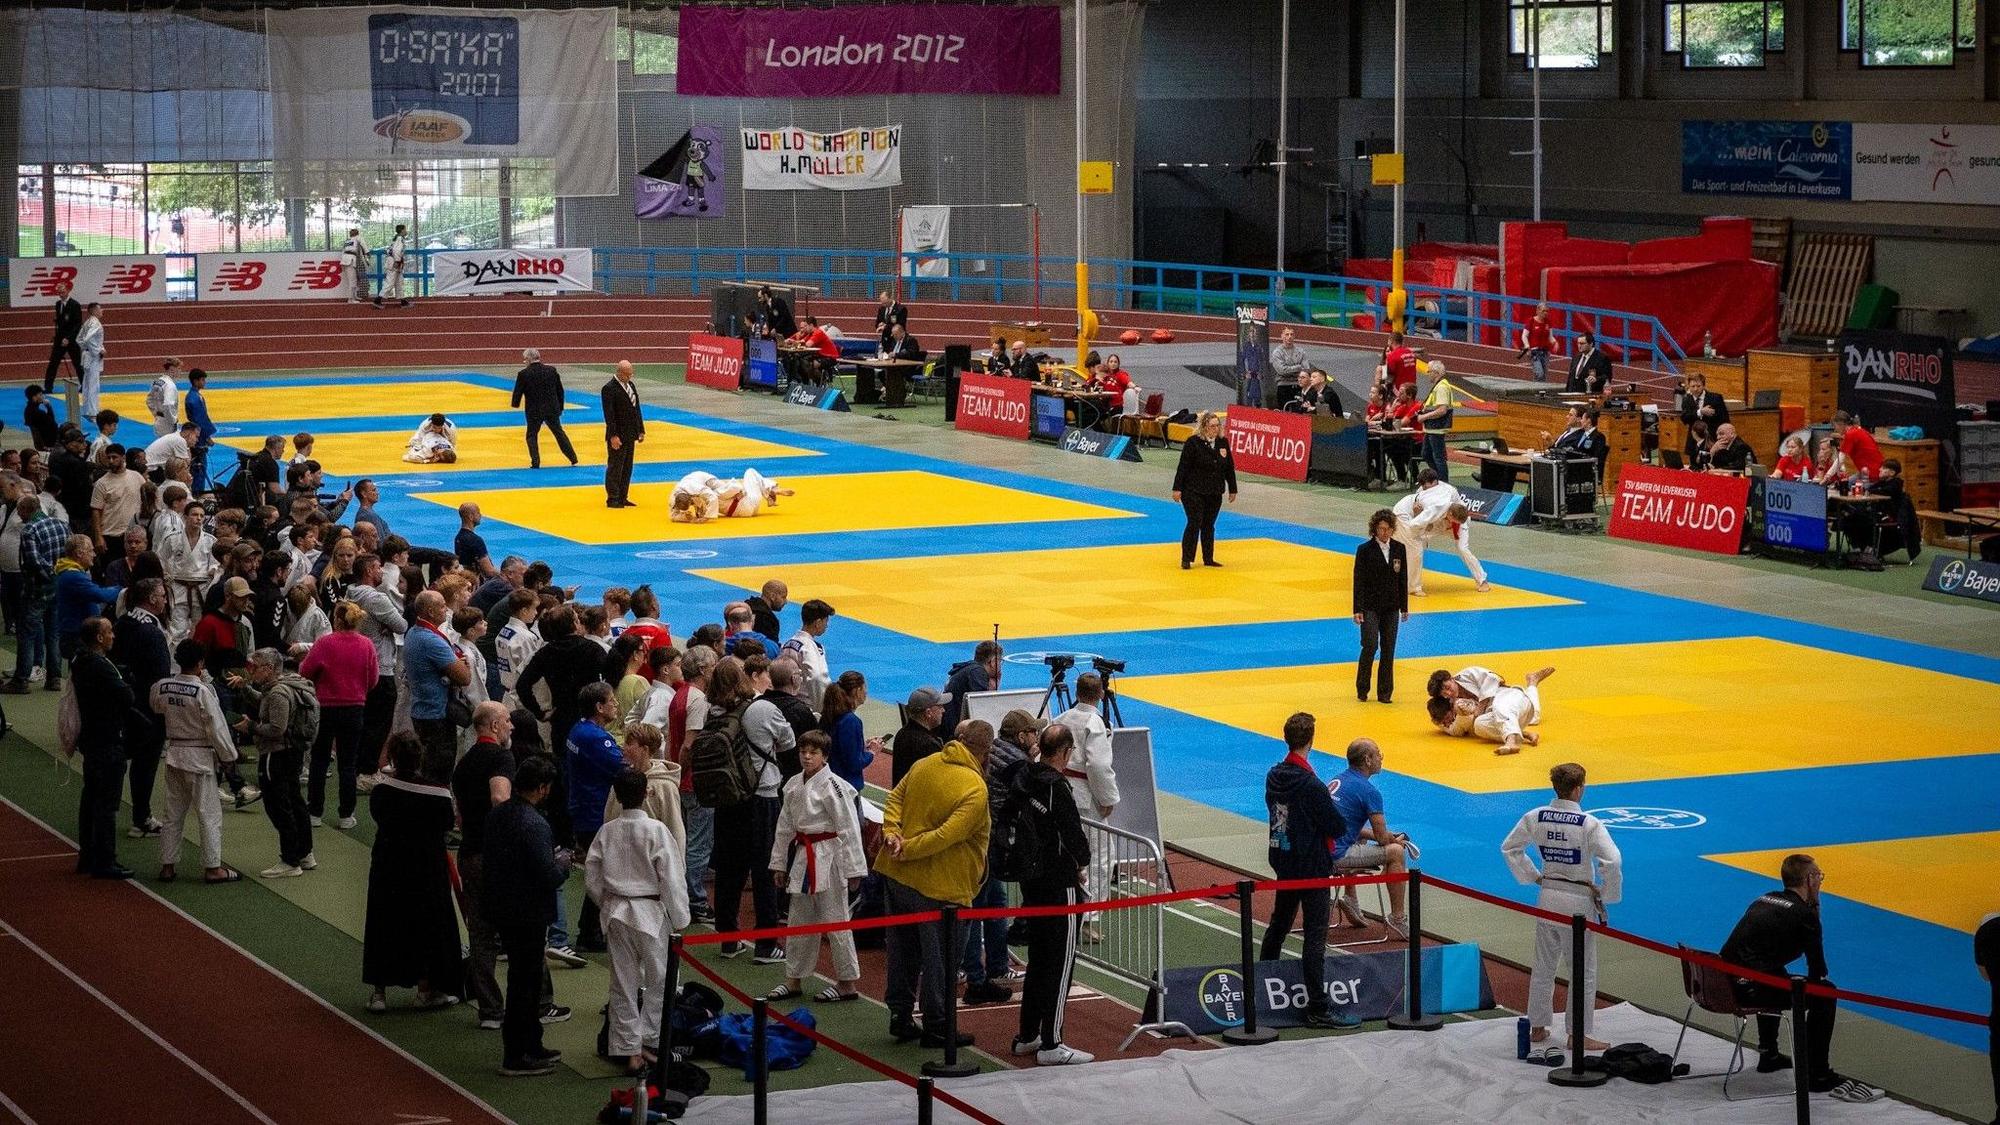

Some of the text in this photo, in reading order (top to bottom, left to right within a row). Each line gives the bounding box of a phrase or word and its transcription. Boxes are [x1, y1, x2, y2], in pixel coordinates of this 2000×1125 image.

[765, 33, 965, 68] London 2012
[440, 72, 500, 96] 2007
[410, 122, 448, 131] IAAF
[744, 128, 899, 152] WORLD CHAMPION
[1856, 152, 1888, 164] Gesund
[1890, 154, 1920, 165] werden
[1730, 180, 1744, 192] und
[1746, 180, 1786, 194] Freizeitbad
[1788, 182, 1796, 193] in
[1798, 183, 1841, 195] Leverkusen
[461, 258, 564, 283] DANRHO
[690, 352, 738, 376] TEAM JUDO
[1844, 345, 1942, 388] DANRHO
[962, 394, 1026, 423] TEAM JUDO
[1077, 436, 1100, 454] Bayer
[1229, 430, 1305, 463] TEAM JUDO
[1661, 484, 1697, 498] LEVERKUSEN
[1768, 492, 1792, 510] 000
[1621, 493, 1736, 533] TEAM JUDO
[1768, 524, 1792, 543] 000
[1542, 812, 1580, 823] PALMAERTS
[1547, 830, 1568, 841] BEL
[1204, 992, 1244, 1004] BAYE
[1264, 978, 1360, 1010] Baer
